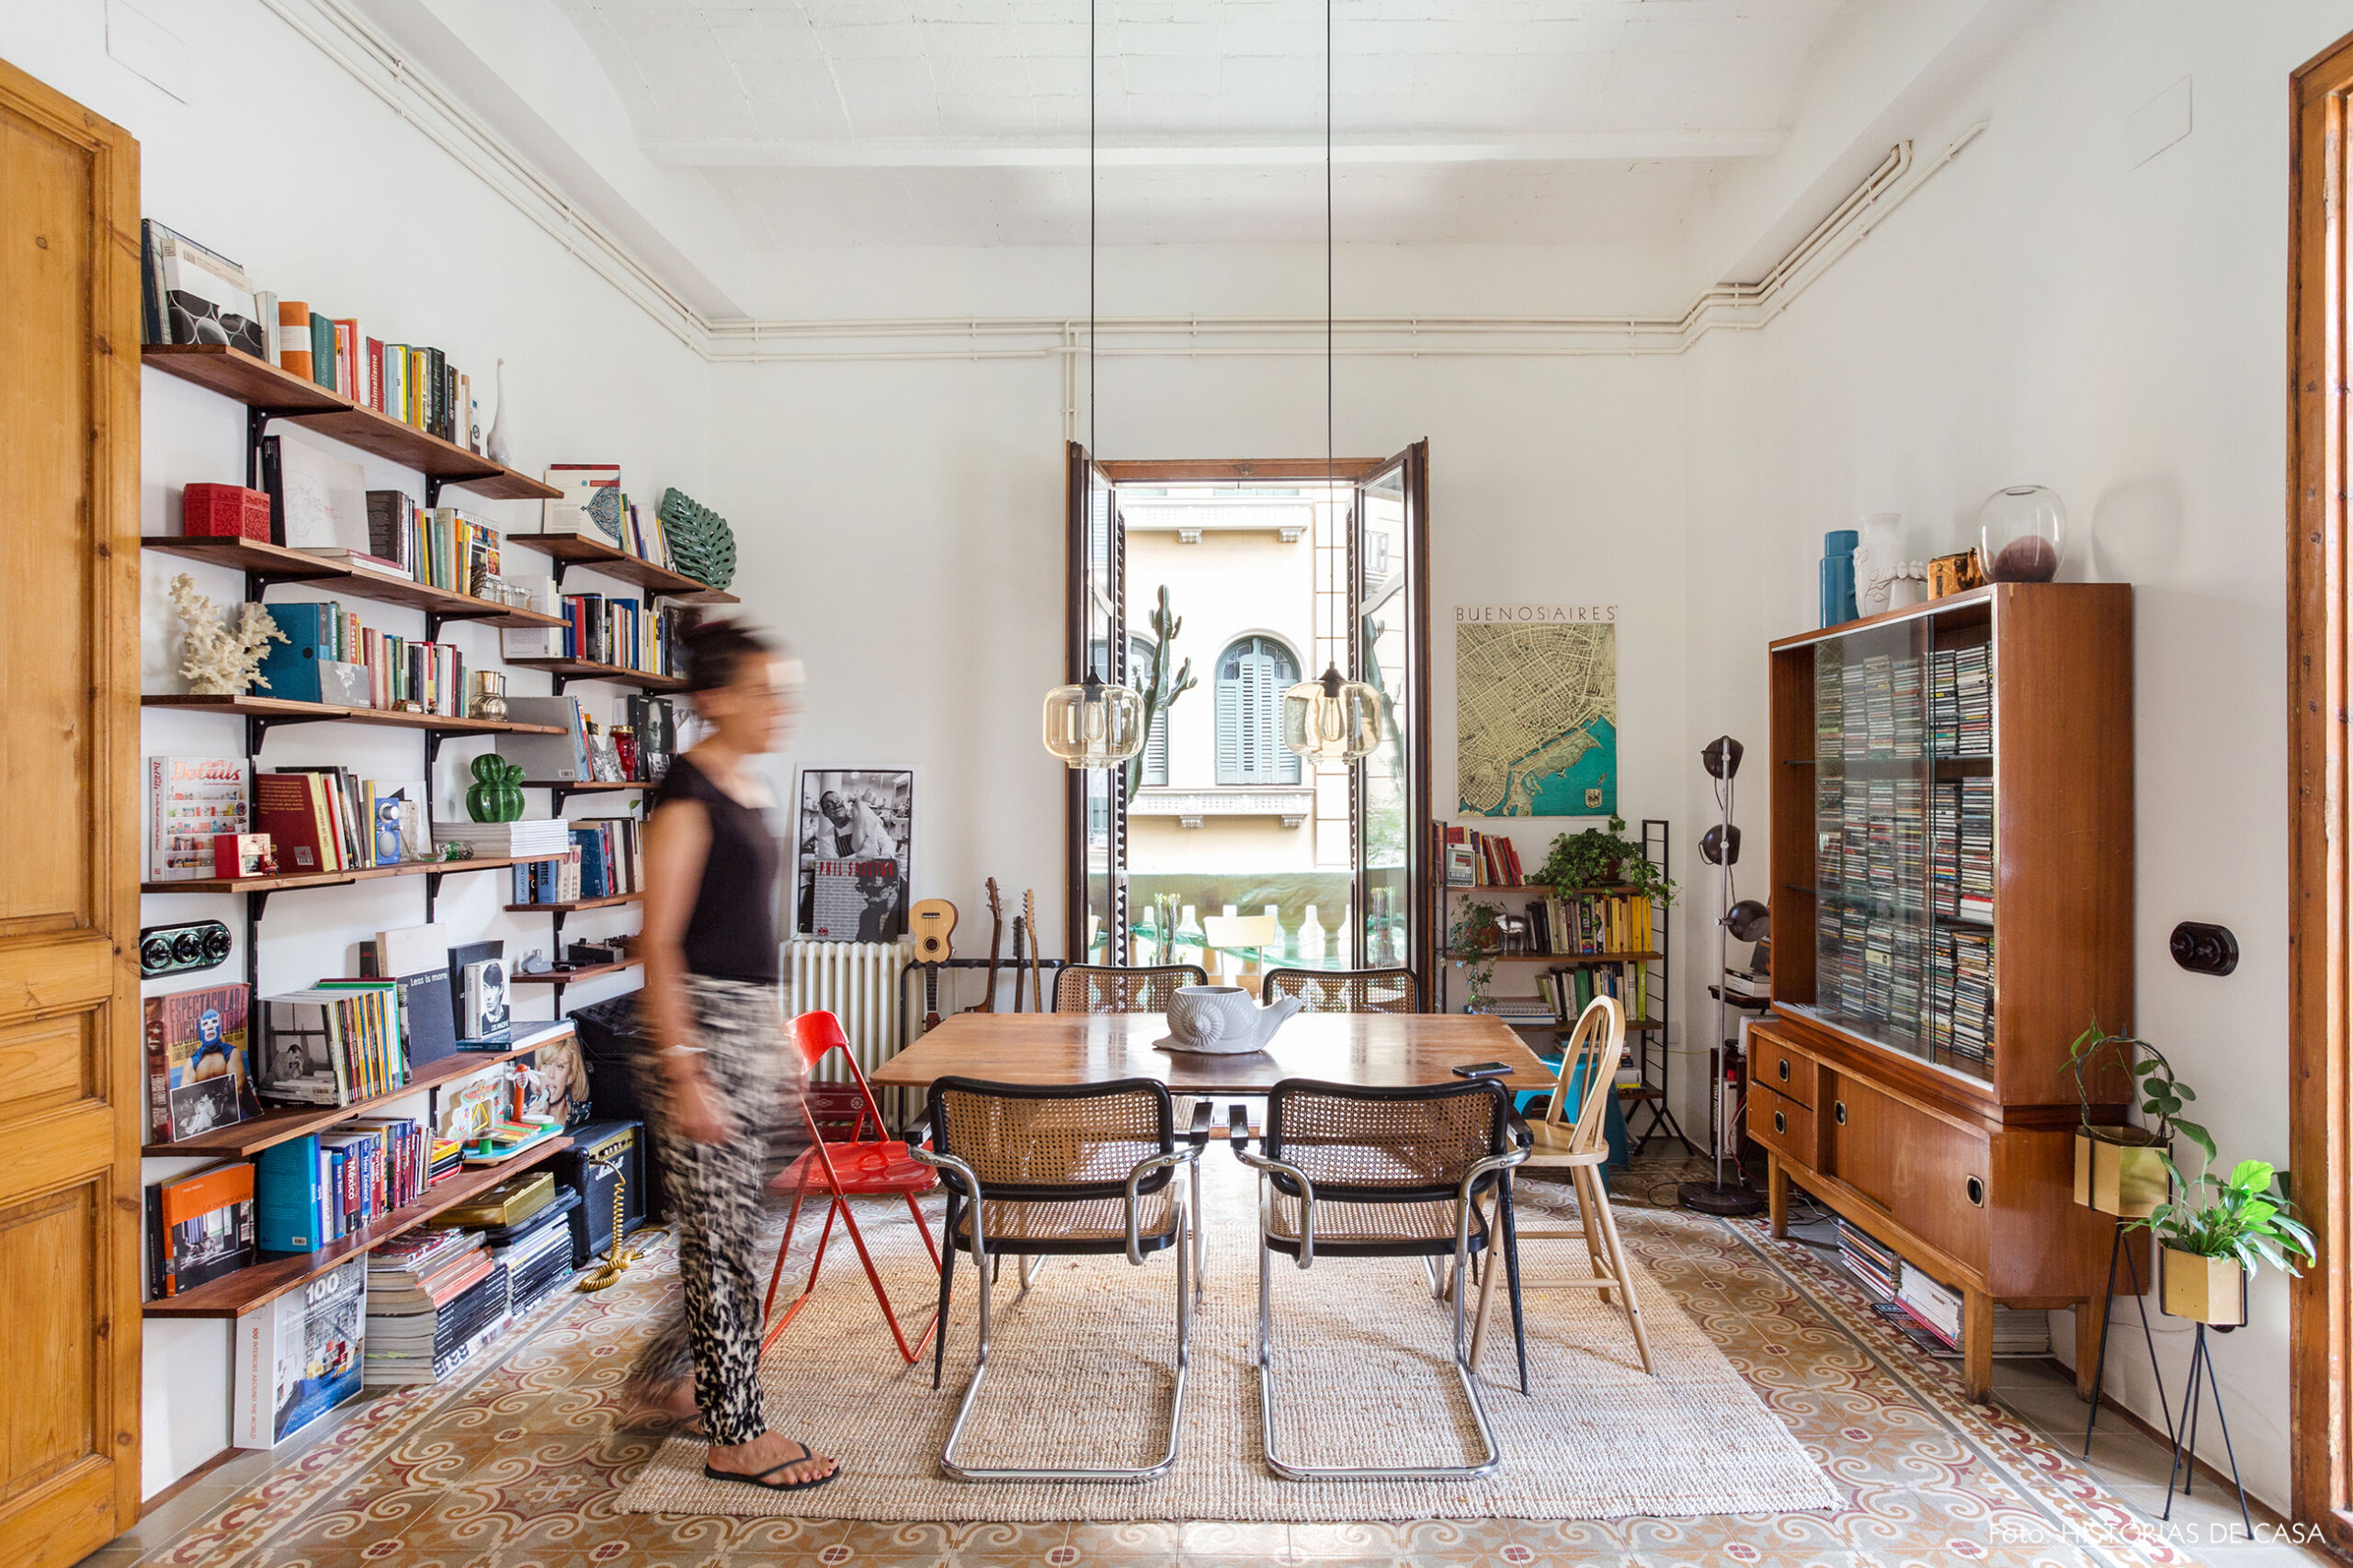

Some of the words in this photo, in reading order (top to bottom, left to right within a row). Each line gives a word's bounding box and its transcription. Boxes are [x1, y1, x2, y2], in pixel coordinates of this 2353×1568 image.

[171, 759, 242, 781] Details
[819, 861, 843, 876] PHIL
[848, 860, 894, 877] SPECTOR
[410, 975, 425, 987] Less
[425, 974, 431, 983] is
[431, 971, 449, 982] more
[347, 1160, 357, 1200] México
[305, 1272, 339, 1305] 100
[1456, 1525, 1546, 1540] BUENOS
[1552, 1524, 1616, 1540] AIRES
